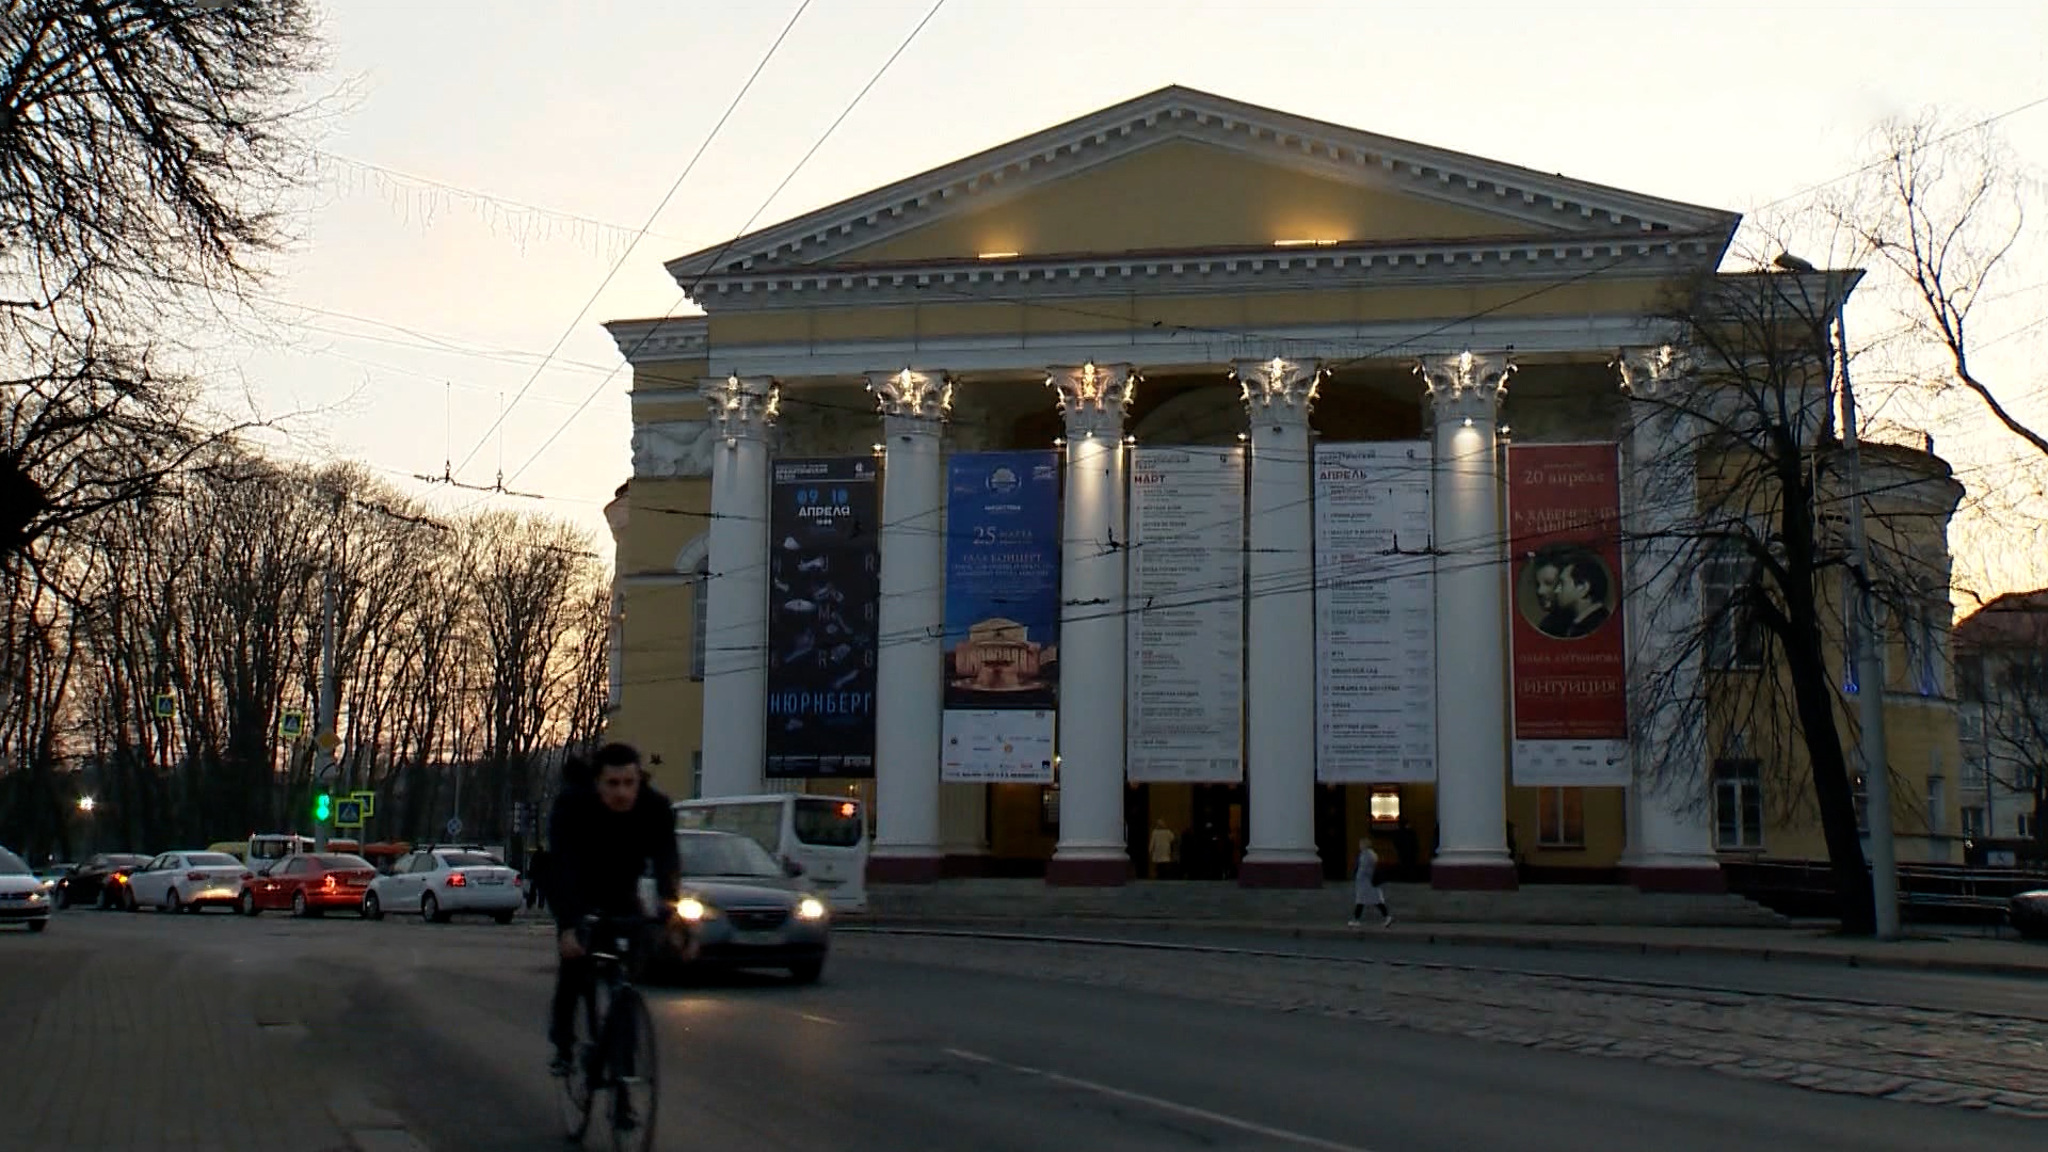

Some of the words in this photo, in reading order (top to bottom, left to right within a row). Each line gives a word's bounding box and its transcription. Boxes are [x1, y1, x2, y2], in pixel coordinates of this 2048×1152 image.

[1134, 474, 1166, 484] МАРТ
[1319, 470, 1368, 480] АПРЕЛЬ
[1525, 470, 1544, 484] 20
[797, 488, 819, 504] 09
[831, 488, 848, 504] 10
[799, 505, 851, 517] АПРЕЛЯ
[973, 526, 997, 544] 25
[1524, 680, 1617, 694] ИНТУИЦИЯ
[770, 691, 871, 714] НЮРНБЕРГ
